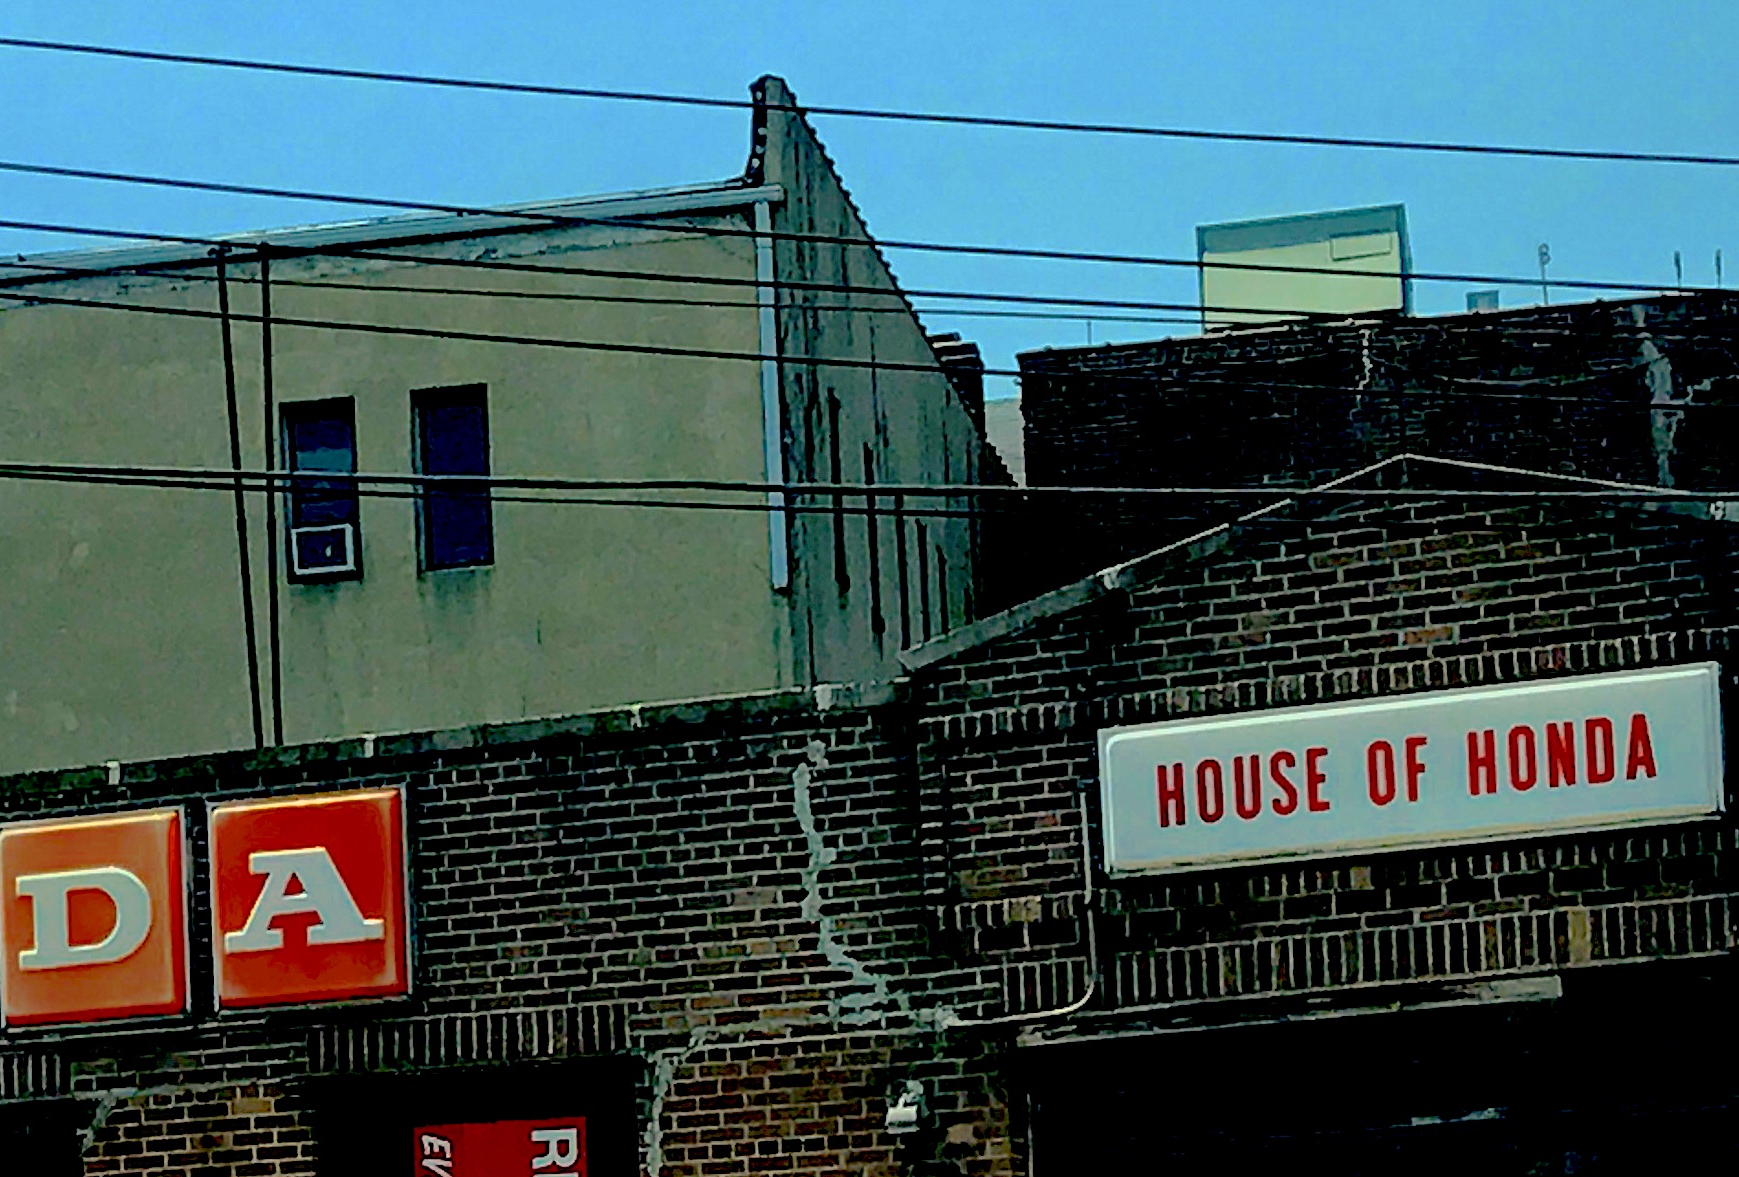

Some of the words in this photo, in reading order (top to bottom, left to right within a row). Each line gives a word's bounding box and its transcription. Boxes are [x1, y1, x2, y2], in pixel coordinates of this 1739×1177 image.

[1156, 747, 1329, 826] HOUSE
[1367, 736, 1426, 806] OF
[1467, 713, 1655, 796] HONDA
